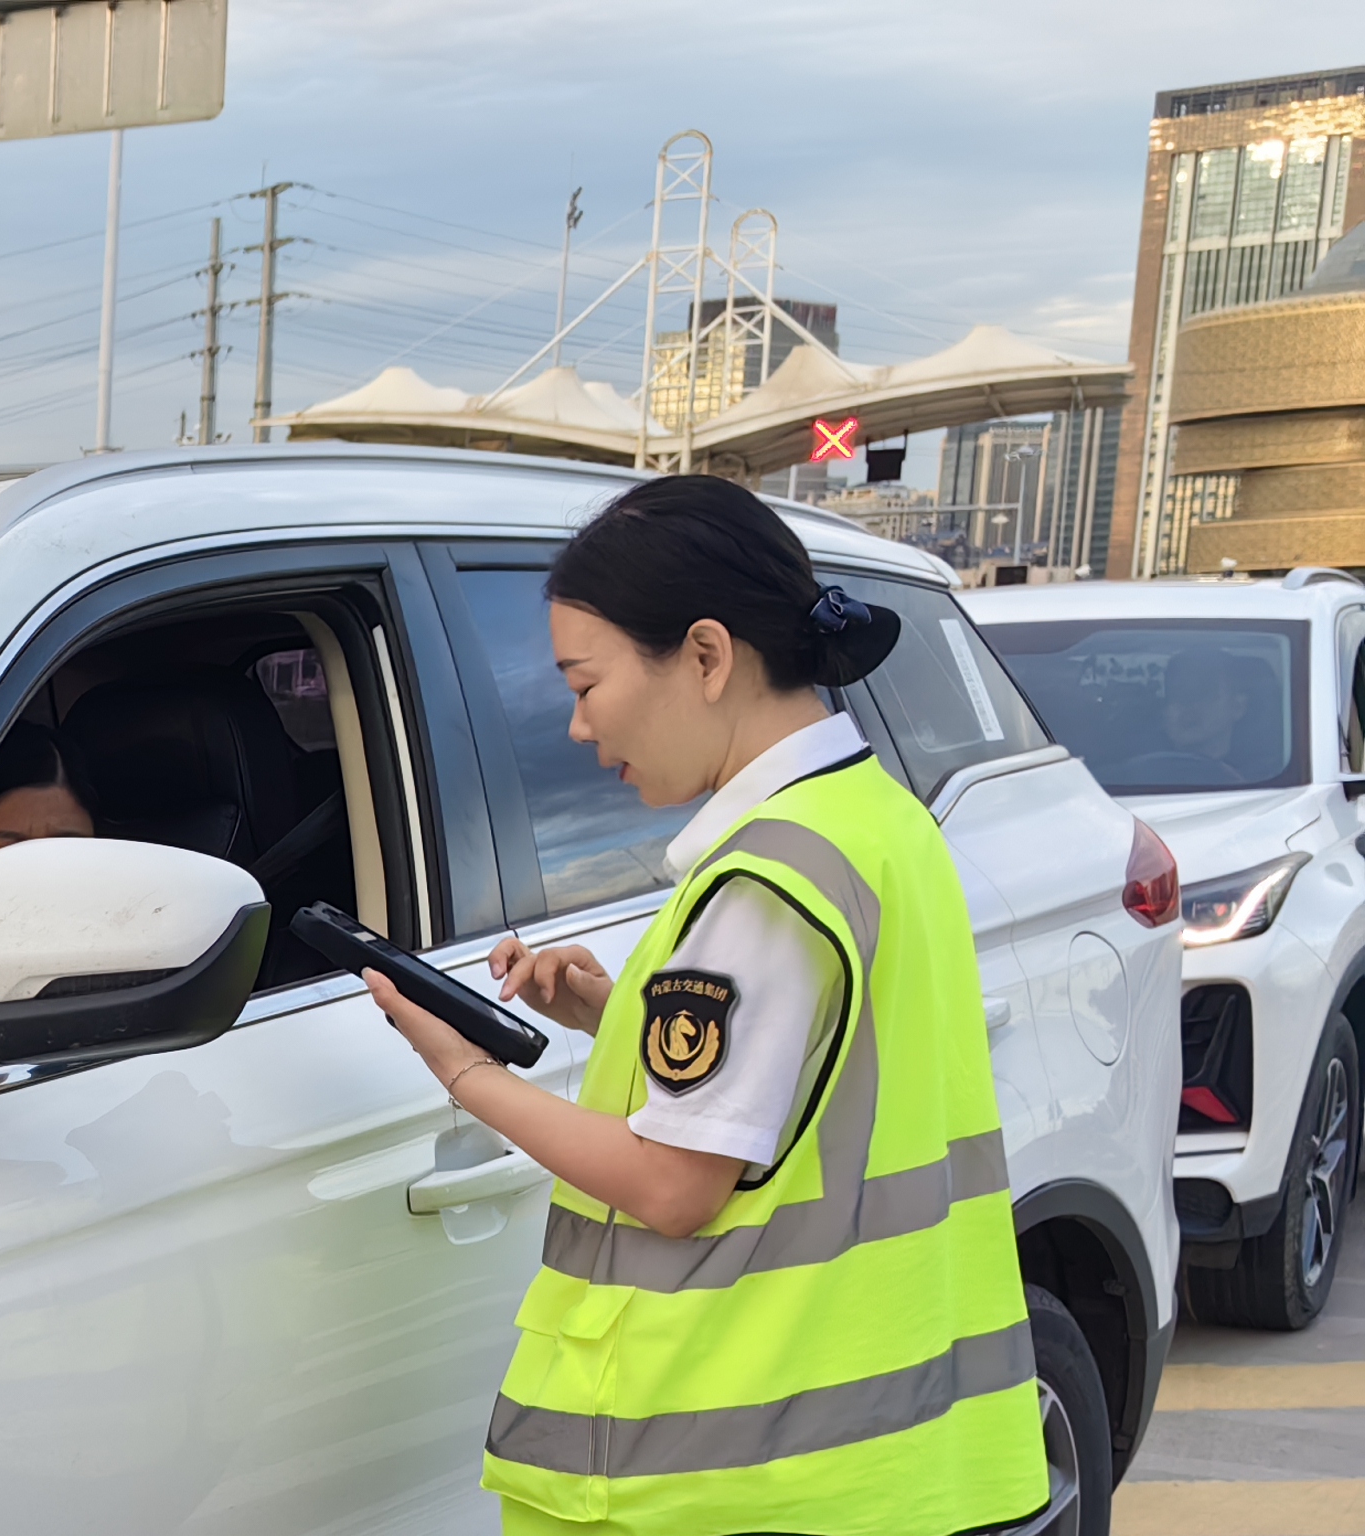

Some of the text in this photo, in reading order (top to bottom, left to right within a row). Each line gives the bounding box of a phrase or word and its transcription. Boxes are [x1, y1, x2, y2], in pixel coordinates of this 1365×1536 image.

[651, 979, 728, 1002] 内蒙古交通集团
